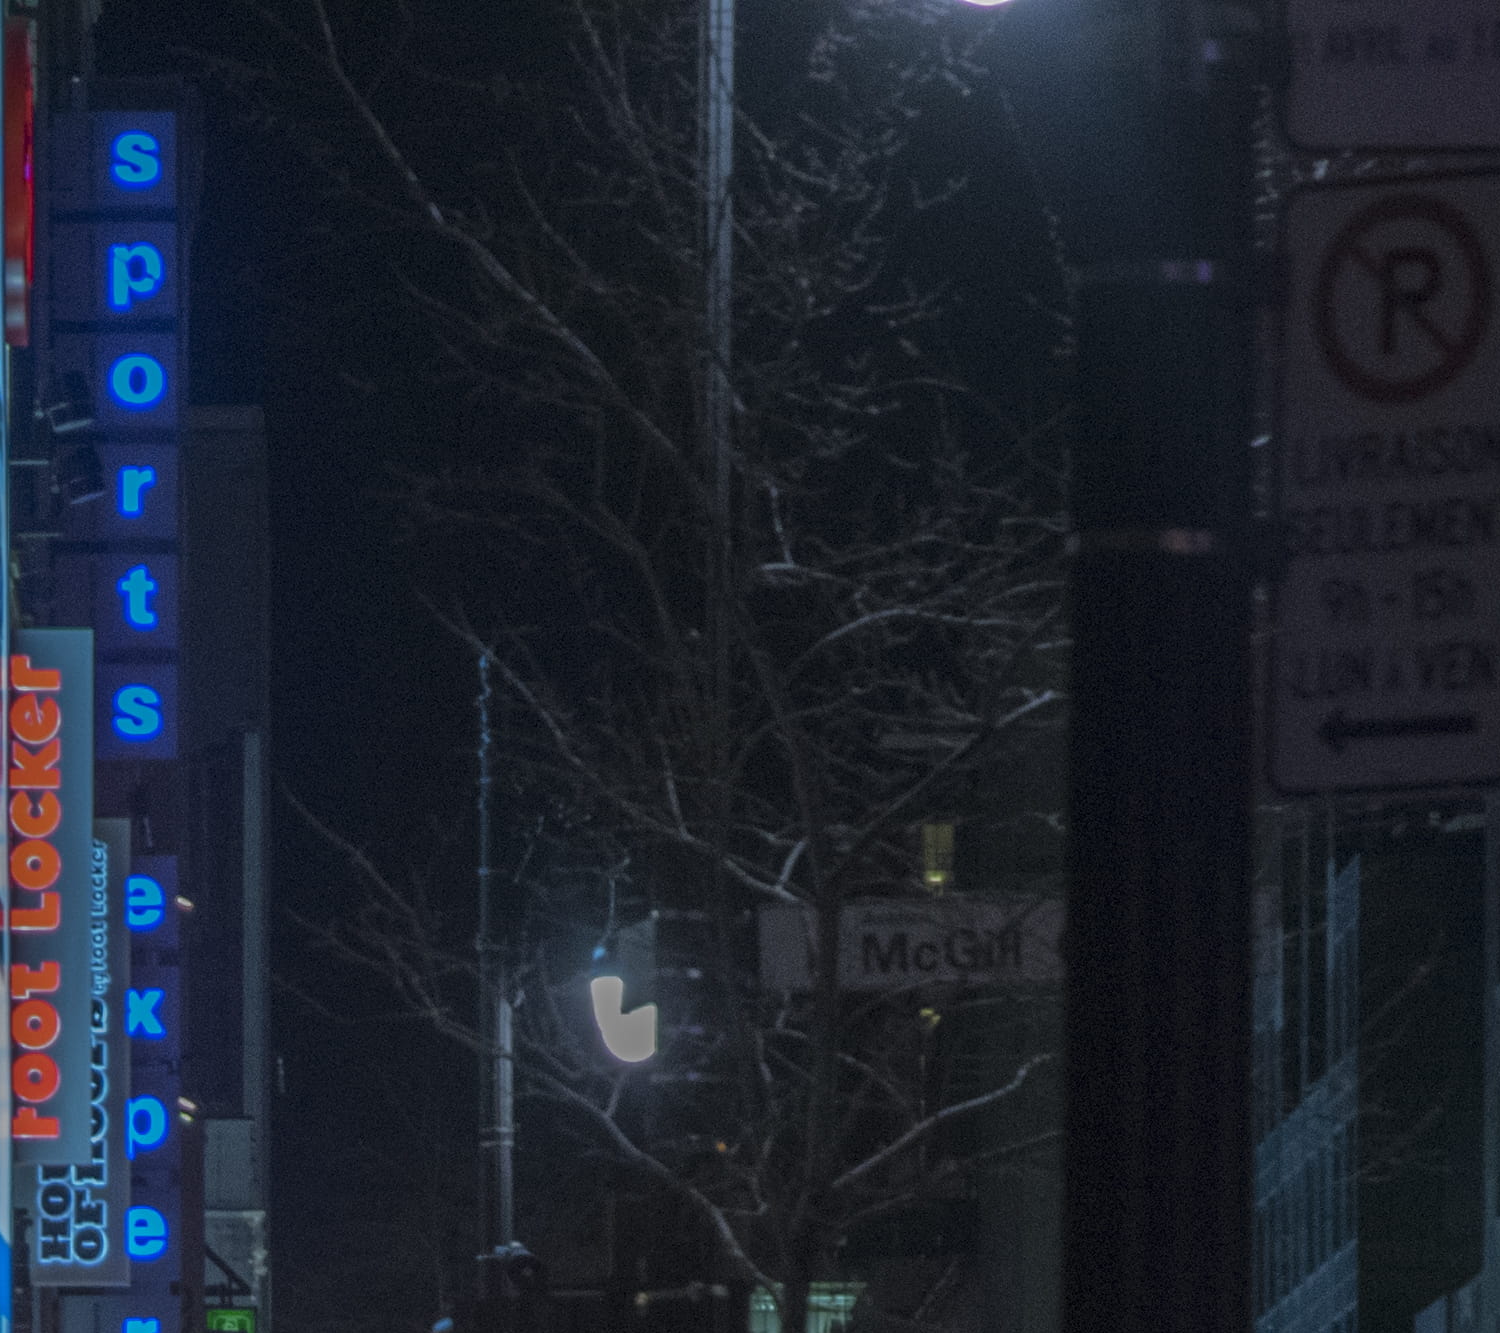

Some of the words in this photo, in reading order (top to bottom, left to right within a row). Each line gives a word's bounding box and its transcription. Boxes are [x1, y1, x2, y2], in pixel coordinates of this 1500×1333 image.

[109, 129, 168, 743] sports
[10, 654, 61, 930] Locker
[861, 930, 1024, 976] McGill
